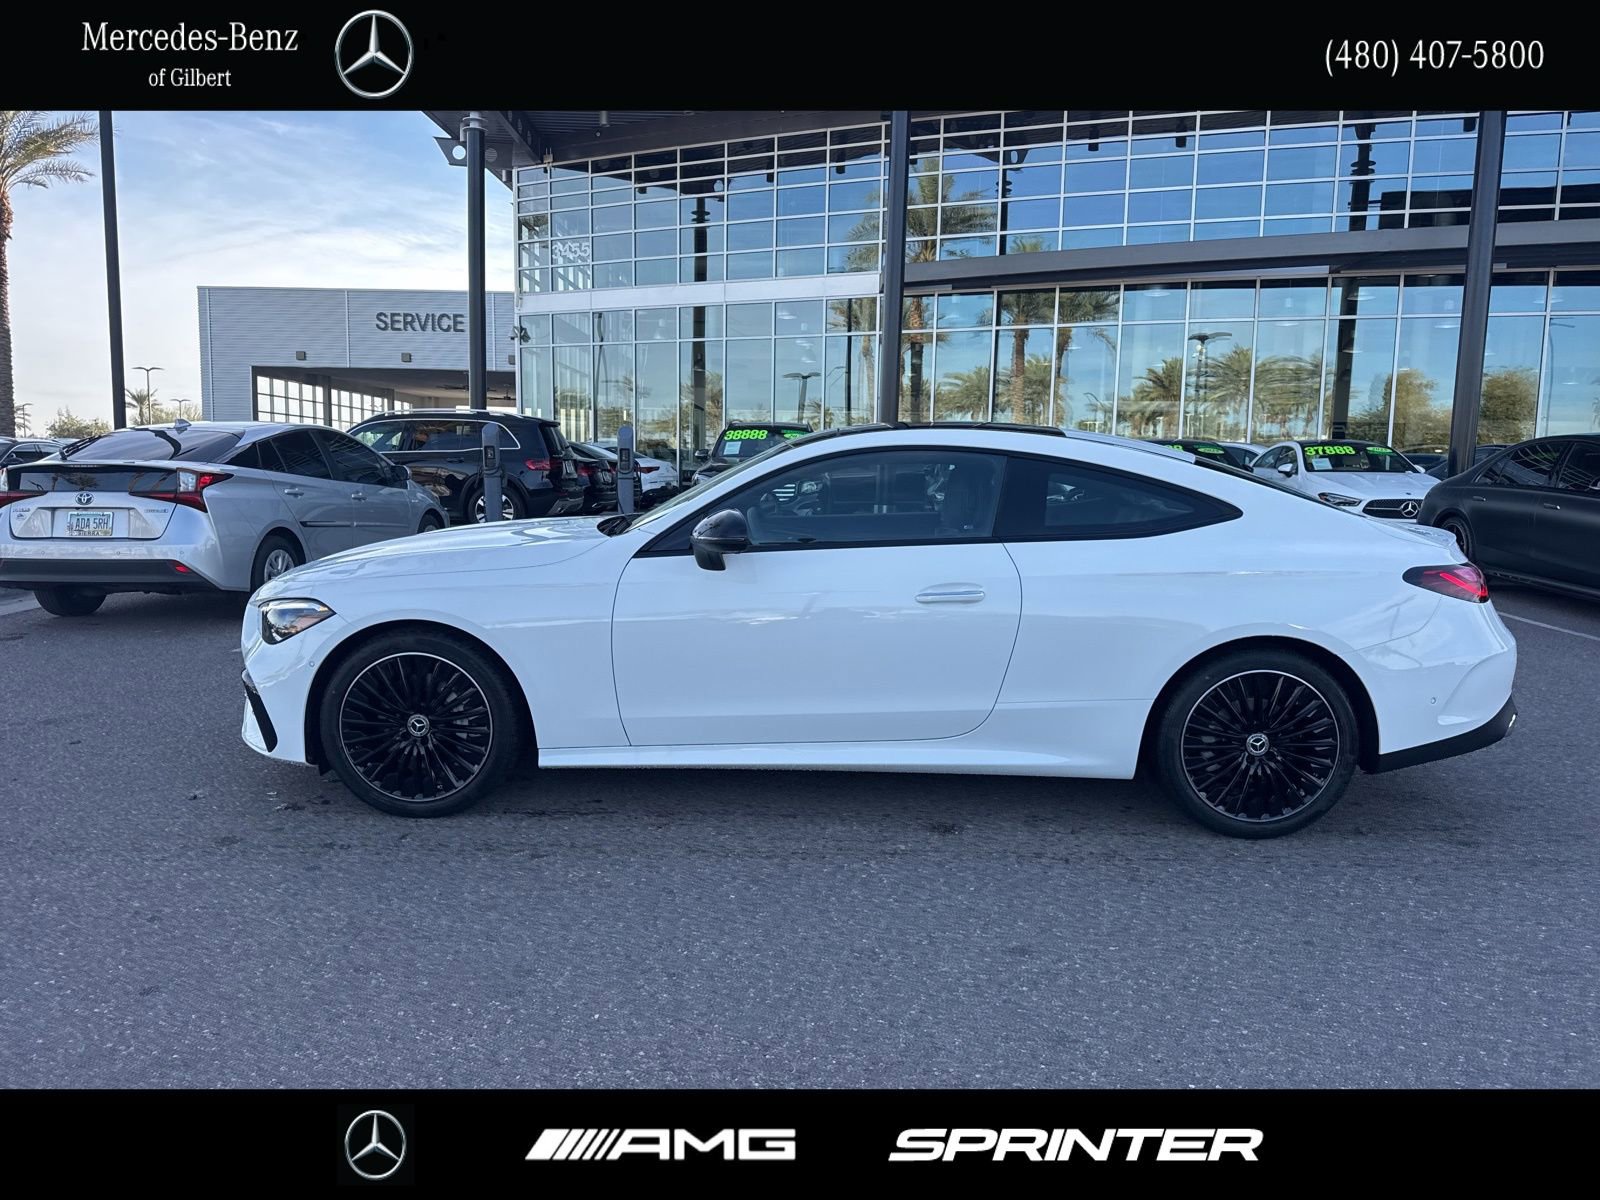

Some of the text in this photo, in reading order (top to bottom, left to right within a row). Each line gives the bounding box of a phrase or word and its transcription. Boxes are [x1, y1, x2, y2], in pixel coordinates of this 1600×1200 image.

[552, 242, 590, 258] 3455
[375, 311, 466, 333] SERVICE
[725, 430, 768, 440] 38888
[1304, 446, 1355, 455] 37888
